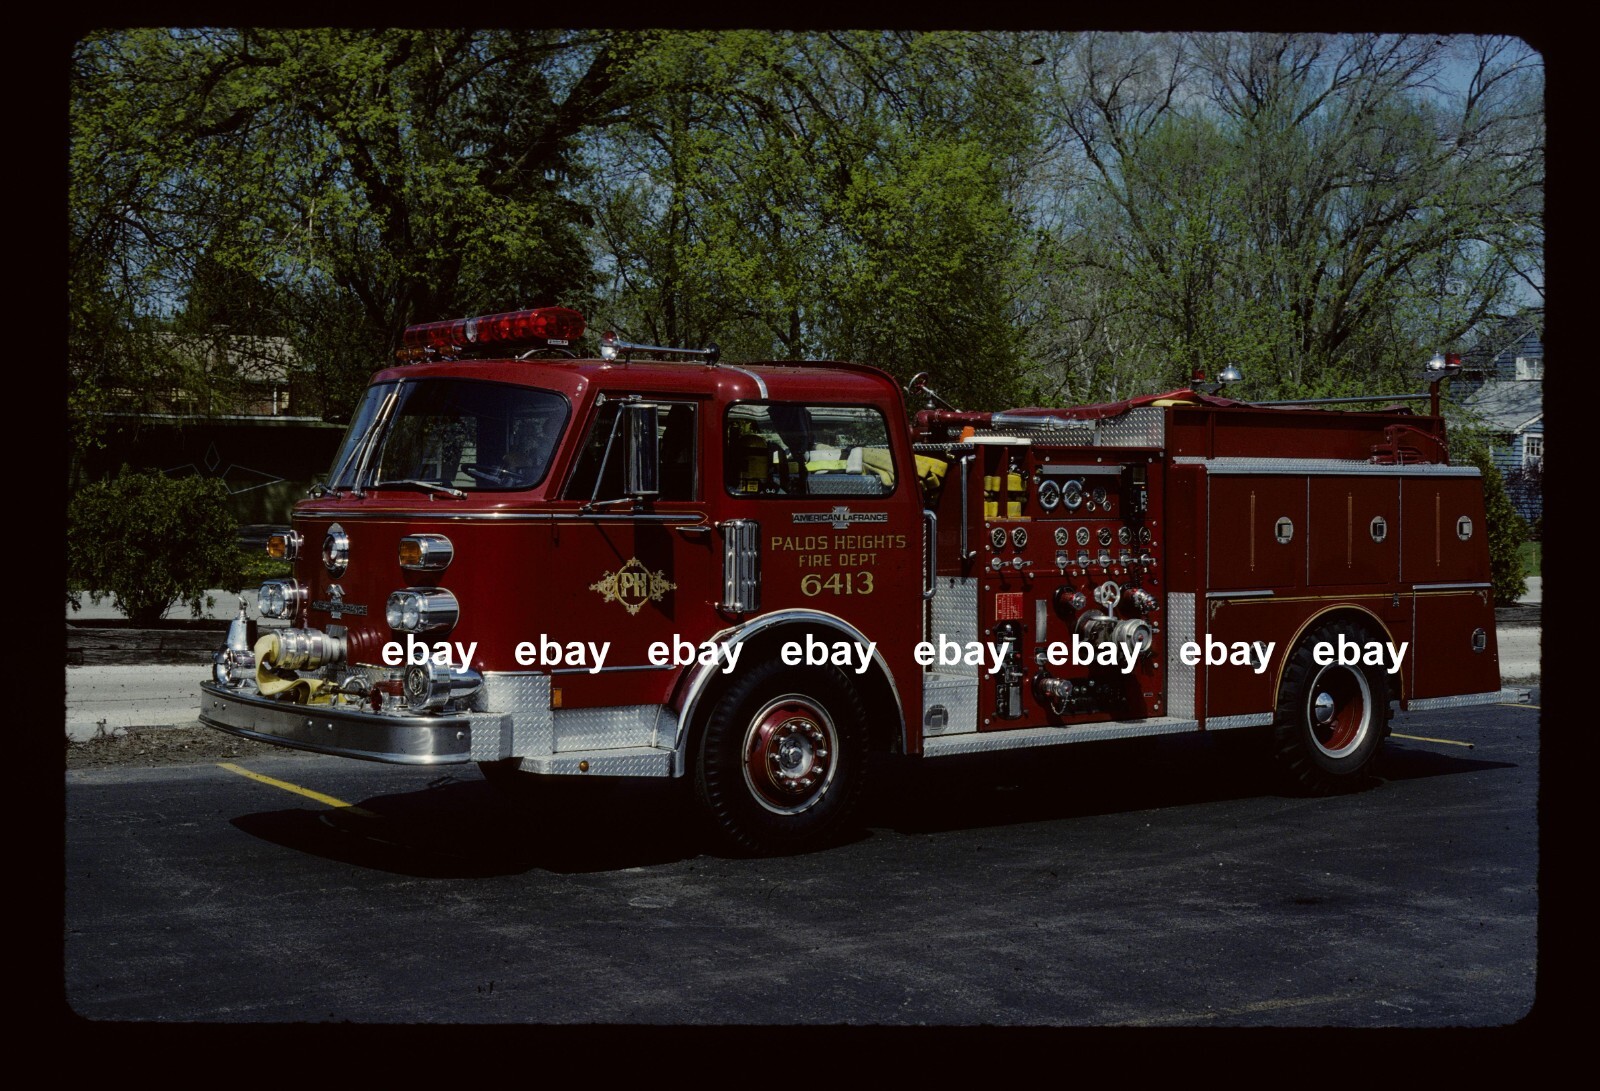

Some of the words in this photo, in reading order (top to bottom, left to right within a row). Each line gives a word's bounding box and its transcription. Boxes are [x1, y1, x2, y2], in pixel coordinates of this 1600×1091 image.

[793, 513, 841, 522] AMERICAN
[771, 535, 828, 551] PALOS
[834, 535, 907, 550] HEIGHTS
[799, 554, 833, 568] FIRE
[800, 571, 874, 597] 6413
